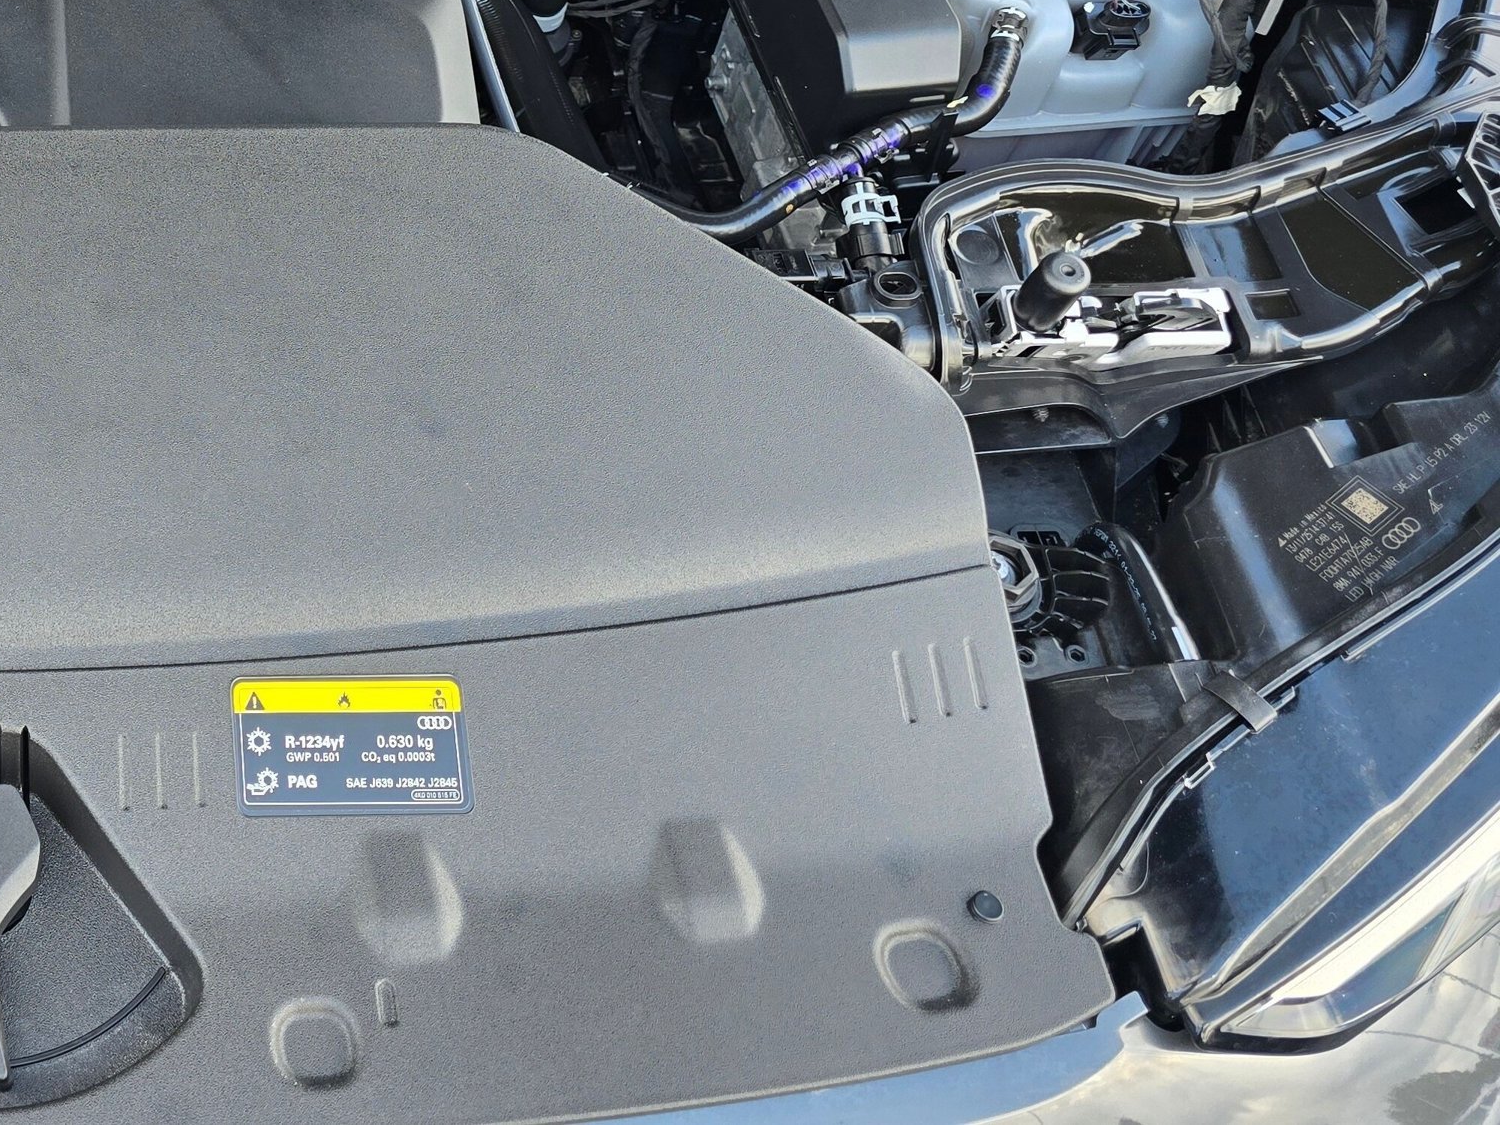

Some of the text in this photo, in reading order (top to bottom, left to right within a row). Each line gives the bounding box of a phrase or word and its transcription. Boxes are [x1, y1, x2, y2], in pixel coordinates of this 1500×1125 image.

[284, 734, 433, 751] R-1234yf 0.630 kg
[285, 752, 312, 762] GWP
[383, 753, 395, 763] eq
[398, 751, 435, 762] 0.0003t
[287, 774, 317, 788] PAG
[345, 777, 457, 788] SAE J639 J2842 J2845
